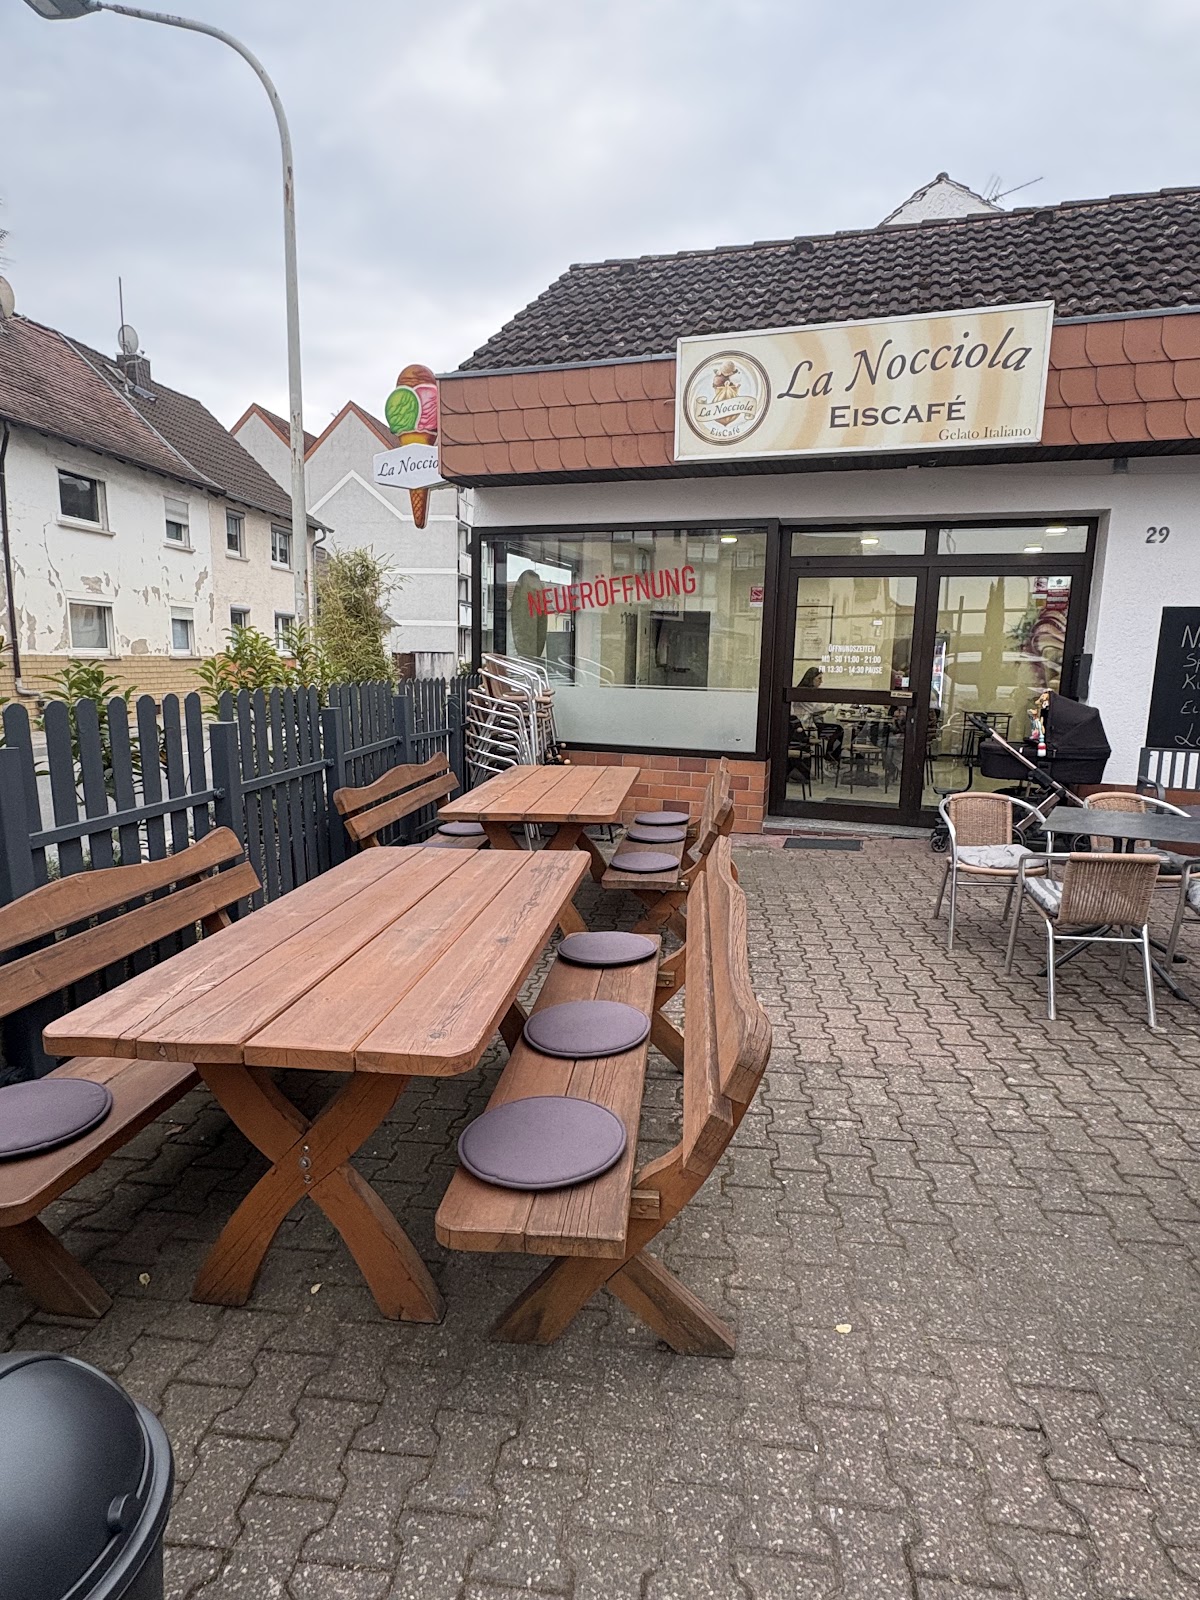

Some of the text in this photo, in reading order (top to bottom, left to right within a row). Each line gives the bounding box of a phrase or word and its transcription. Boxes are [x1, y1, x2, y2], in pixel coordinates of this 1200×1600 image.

[777, 327, 1033, 400] La Nocciola
[698, 401, 754, 418] La Nocciola
[938, 425, 1032, 442] Gelato Italiano
[377, 462, 395, 477] La
[1145, 526, 1171, 544] 29
[527, 565, 697, 618] NEUERÖFFNUNG
[828, 643, 876, 653] ÖFFNUNGSZEITEN
[844, 655, 860, 664] 11:00
[864, 655, 882, 664] 21:00
[864, 666, 883, 675] PAUSE
